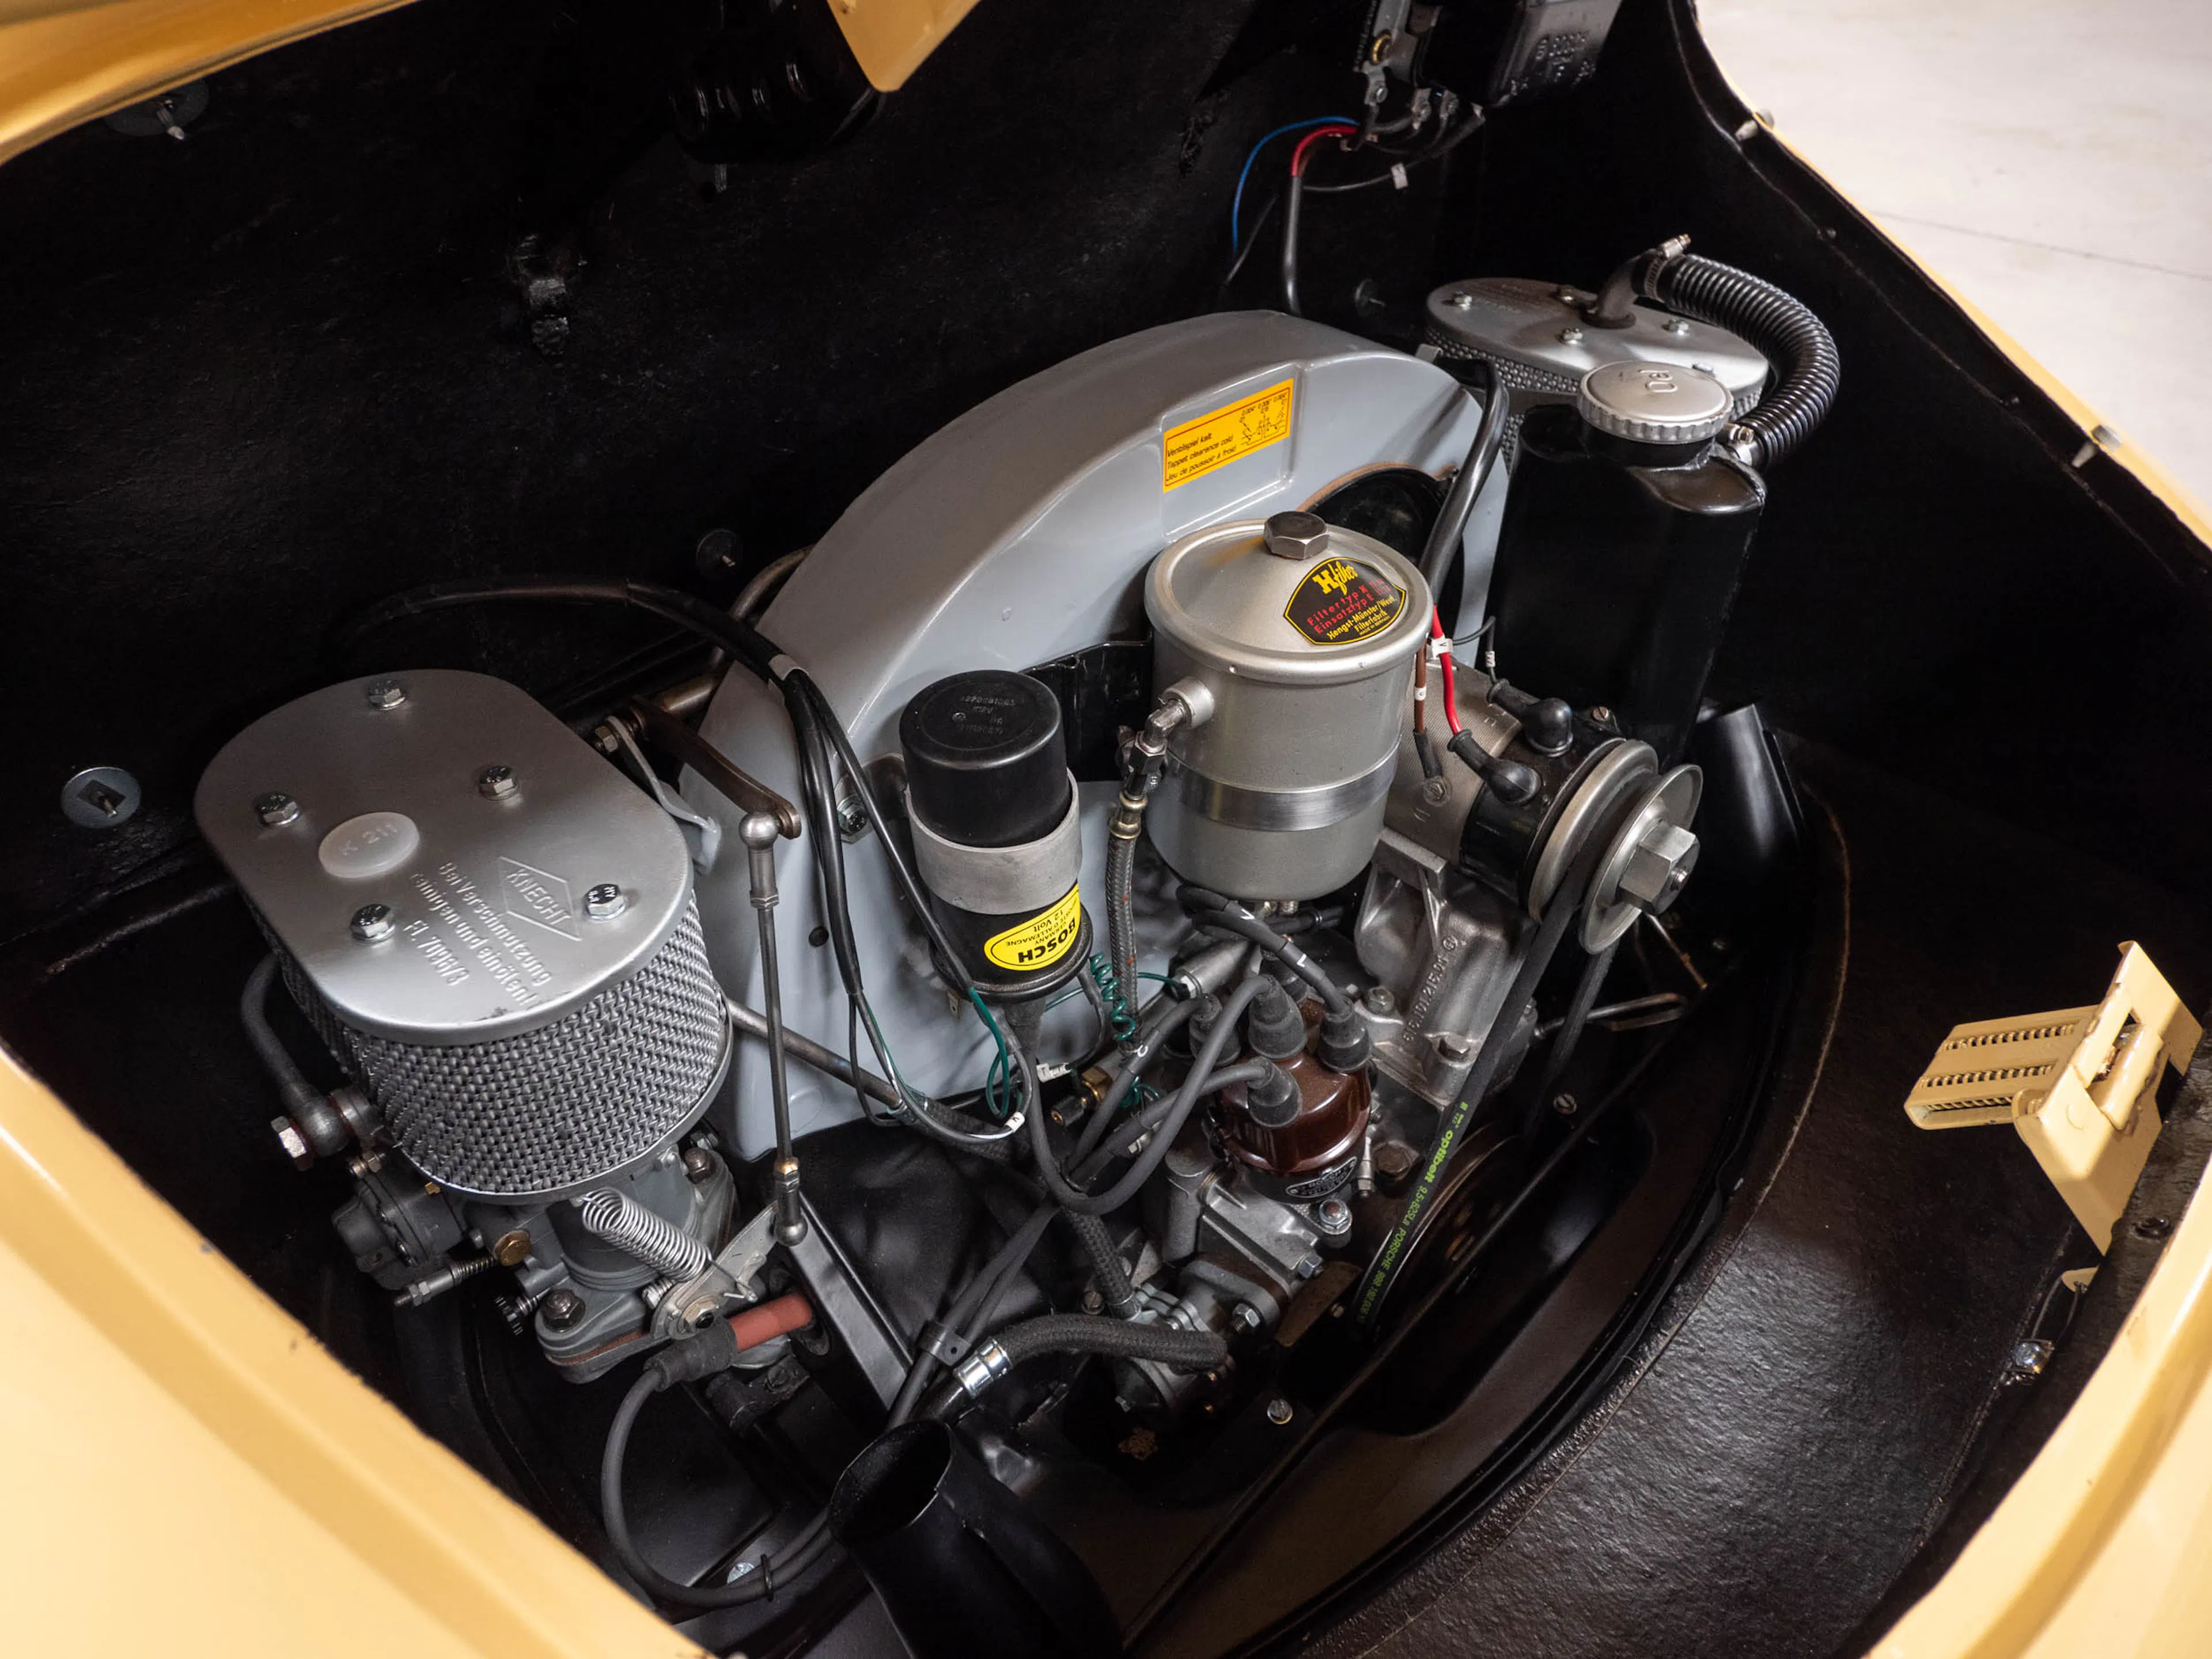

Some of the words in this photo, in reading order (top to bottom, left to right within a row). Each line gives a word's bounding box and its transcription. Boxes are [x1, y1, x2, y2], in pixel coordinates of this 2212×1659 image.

[1168, 455, 1188, 470] Tappet
[1190, 442, 1219, 460] clearance
[1221, 434, 1234, 446] cold
[1200, 433, 1212, 444] kalt
[1166, 471, 1178, 482] Jeu
[1222, 445, 1237, 457] froid
[1354, 609, 1388, 633] Filterfabrik
[409, 870, 460, 926] reinigen
[454, 921, 488, 950] und
[505, 868, 571, 926] KNECHT
[1055, 909, 1063, 919] 12
[438, 860, 467, 887] Bei
[455, 880, 553, 987] Verschmutzung
[1005, 922, 1058, 946] D'ALLEMAGNE
[1018, 917, 1075, 963] BOSCH
[1033, 919, 1051, 932] Volt
[1035, 922, 1067, 945] GERMANY
[1423, 1128, 1455, 1183] optibelt
[1380, 1226, 1407, 1270] PORSCHE
